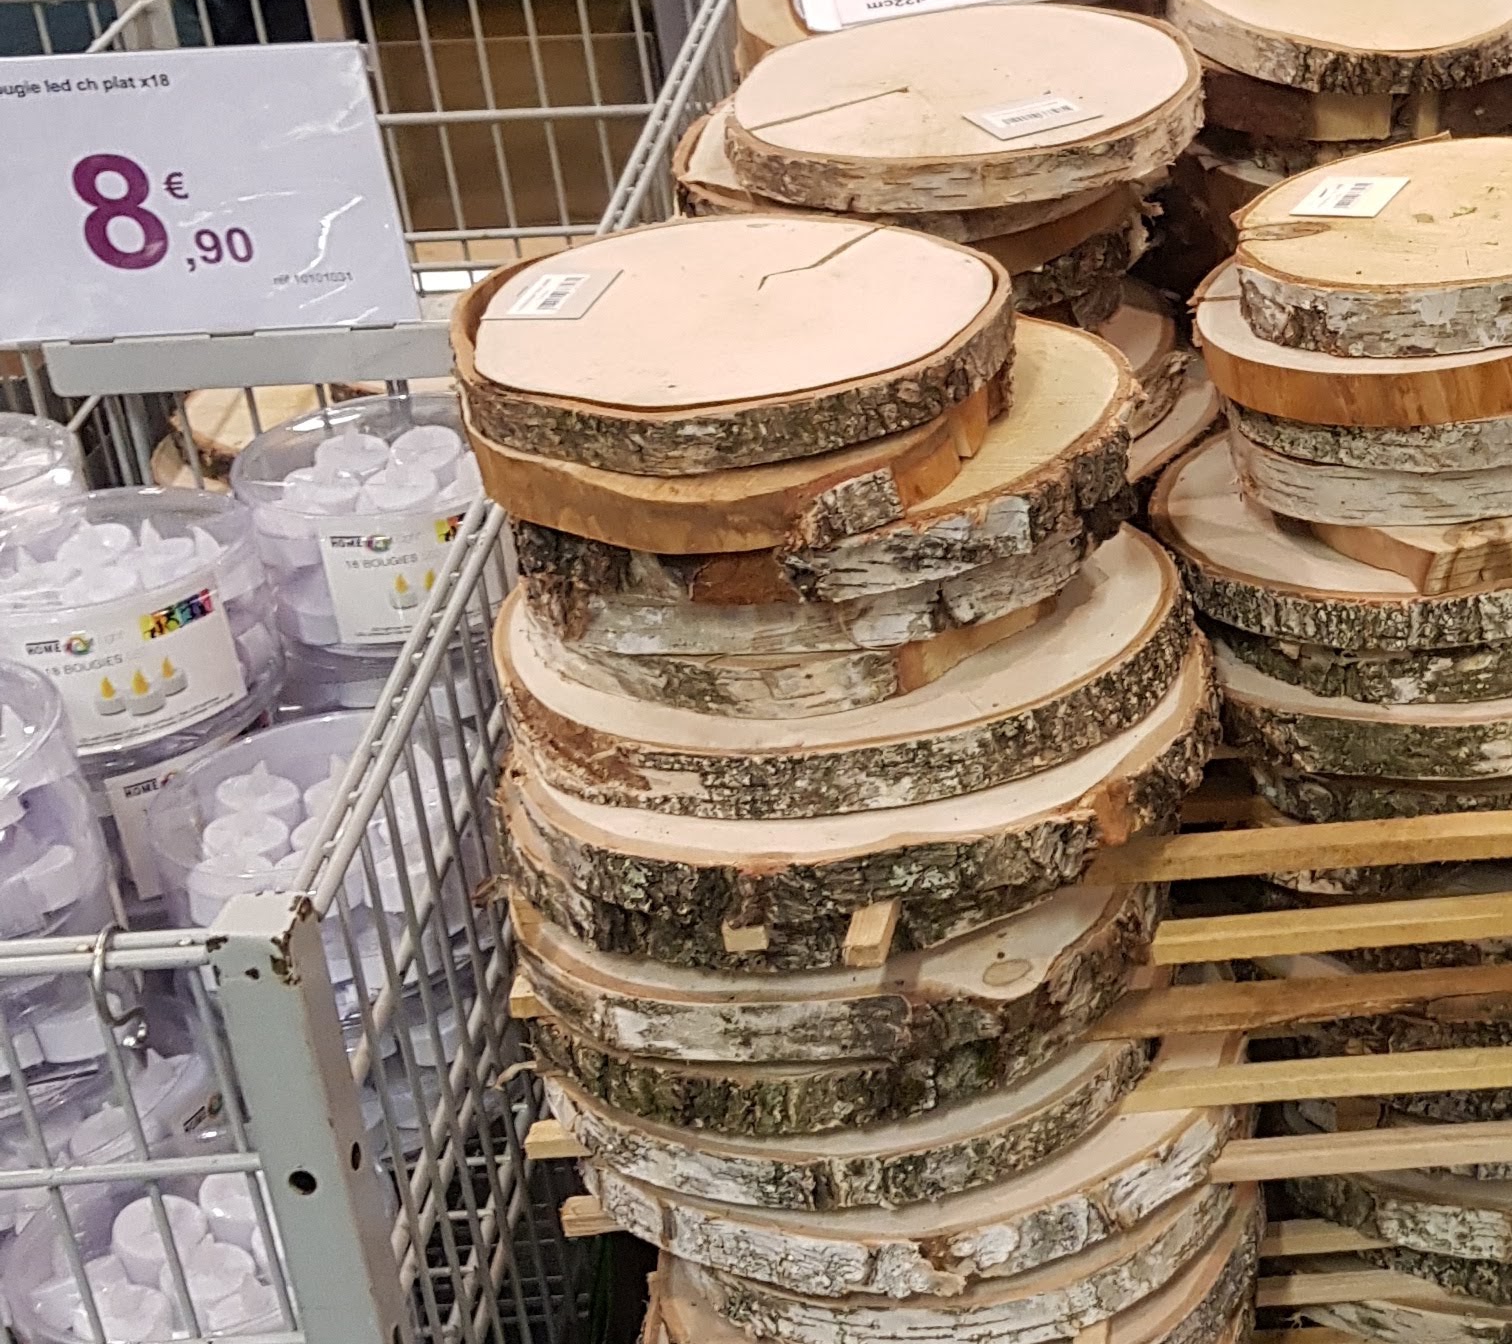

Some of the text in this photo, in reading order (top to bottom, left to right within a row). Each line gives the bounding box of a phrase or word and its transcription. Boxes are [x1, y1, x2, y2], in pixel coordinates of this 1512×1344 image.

[44, 78, 72, 93] led
[76, 78, 99, 92] ch
[102, 75, 136, 93] plat
[140, 74, 170, 88] x18
[71, 153, 254, 272] 8 € ,90
[26, 641, 61, 655] HOME
[63, 654, 123, 674] BOUGIES
[124, 779, 159, 797] HOME
